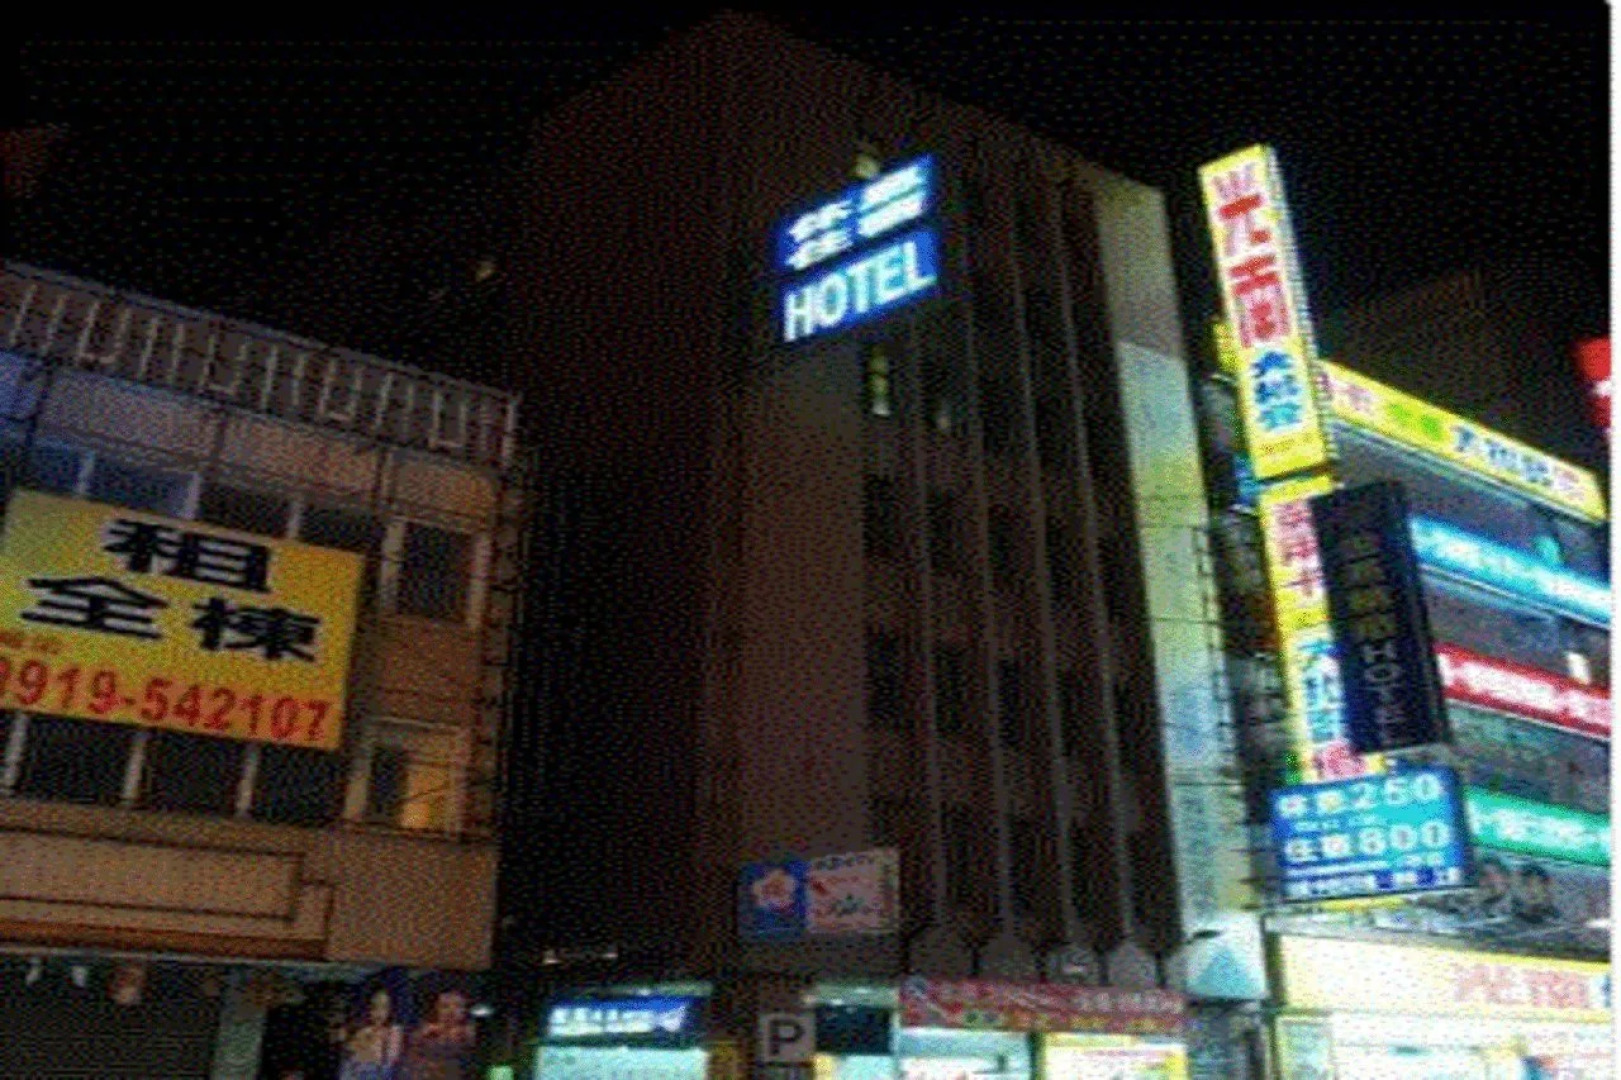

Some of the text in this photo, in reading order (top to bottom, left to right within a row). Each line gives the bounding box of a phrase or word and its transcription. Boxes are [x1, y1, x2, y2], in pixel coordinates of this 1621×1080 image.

[783, 240, 937, 343] HOTEL
[104, 518, 272, 595] 租
[769, 1019, 805, 1056] P
